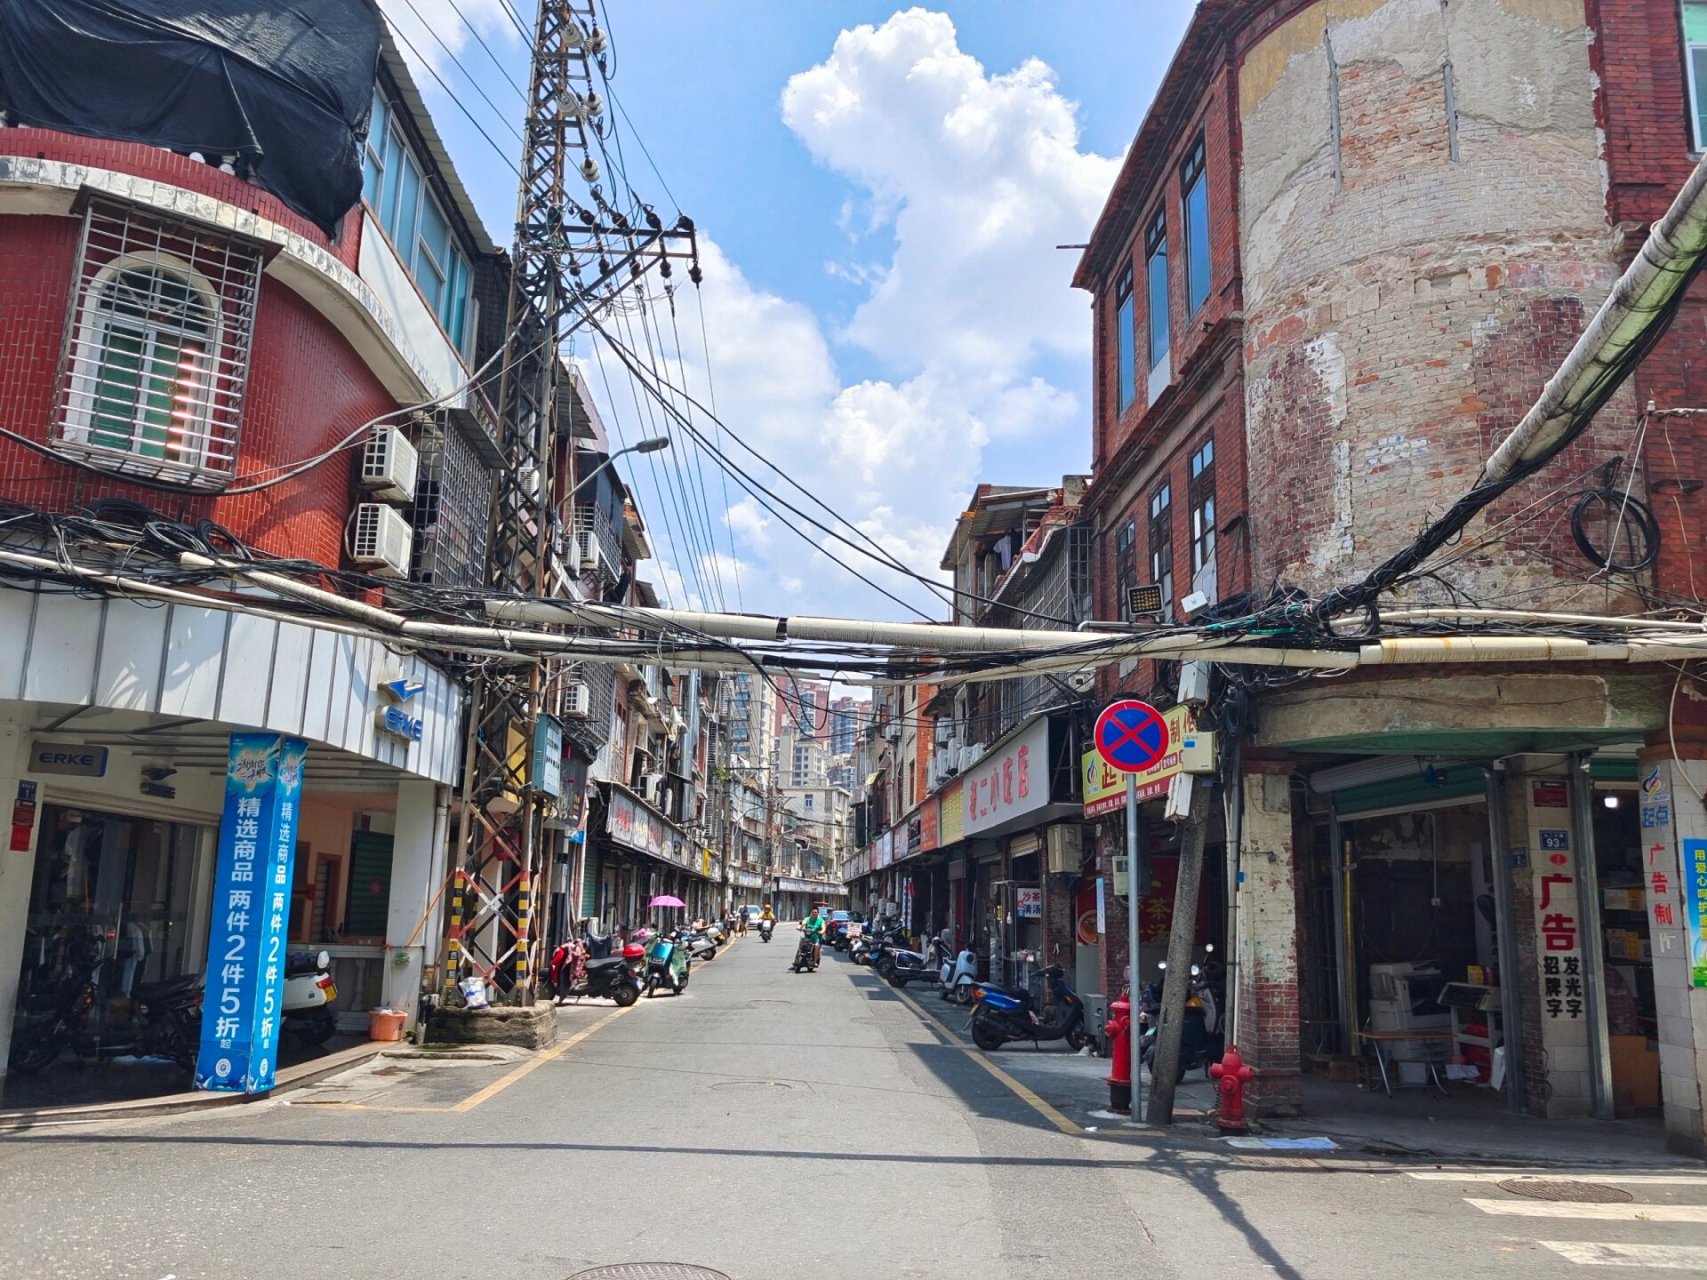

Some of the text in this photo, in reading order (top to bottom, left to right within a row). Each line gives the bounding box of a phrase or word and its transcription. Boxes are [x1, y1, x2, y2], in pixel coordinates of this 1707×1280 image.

[38, 752, 95, 766] ERKE
[1169, 711, 1195, 745] 制作
[969, 744, 1030, 821] 老二小吃店
[231, 797, 262, 882] 精选商品
[274, 802, 293, 885] 精选商品
[1022, 891, 1041, 902] 沙茶
[1138, 896, 1171, 920] 茶
[1539, 872, 1576, 951] 广告
[1543, 955, 1563, 1018] 招牌字
[1563, 957, 1583, 1019] 发光字
